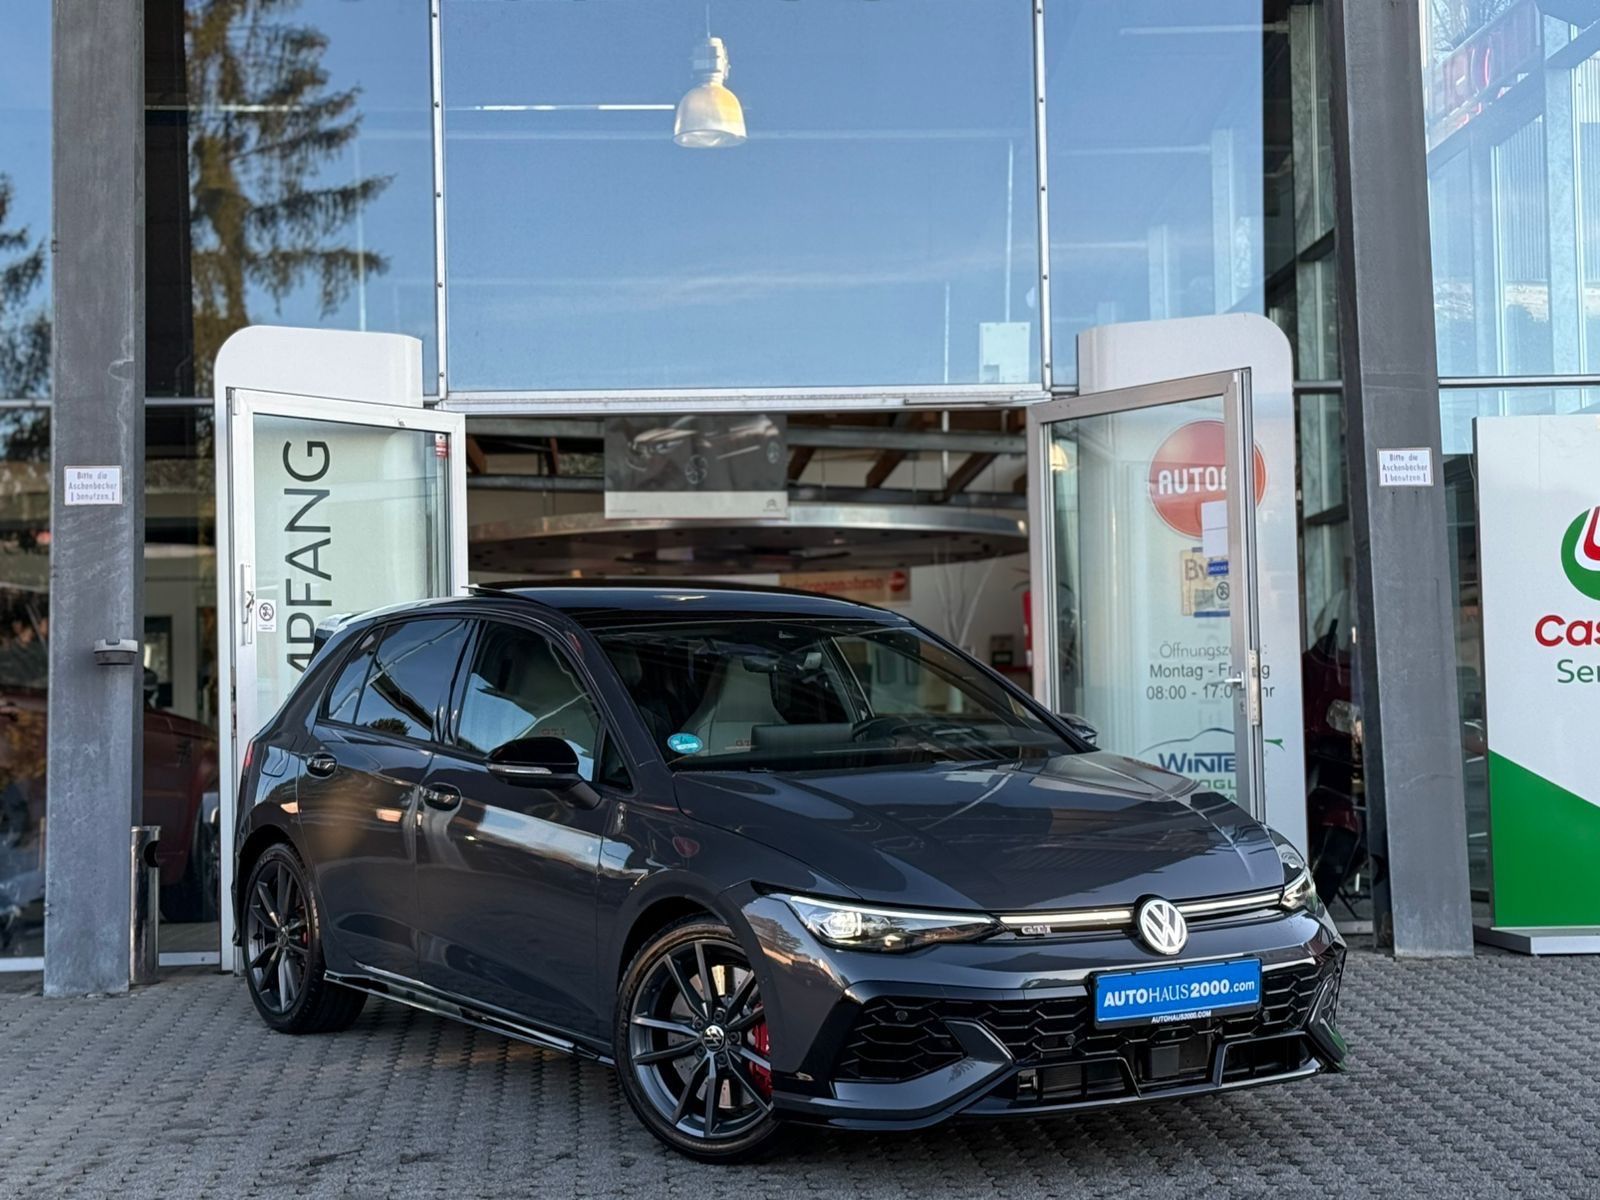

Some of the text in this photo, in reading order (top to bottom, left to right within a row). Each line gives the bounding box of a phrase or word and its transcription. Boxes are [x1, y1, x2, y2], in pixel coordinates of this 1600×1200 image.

[77, 472, 93, 480] Bitte
[1159, 466, 1227, 495] AUTO
[283, 440, 332, 673] PFANG
[1150, 664, 1203, 680] Montag
[1147, 685, 1186, 700] 08:00
[1203, 684, 1234, 699] 17:0
[1158, 752, 1236, 773] WINTE
[1021, 924, 1052, 936] GTI
[1103, 978, 1255, 1008] AUTOHAUS2000.com
